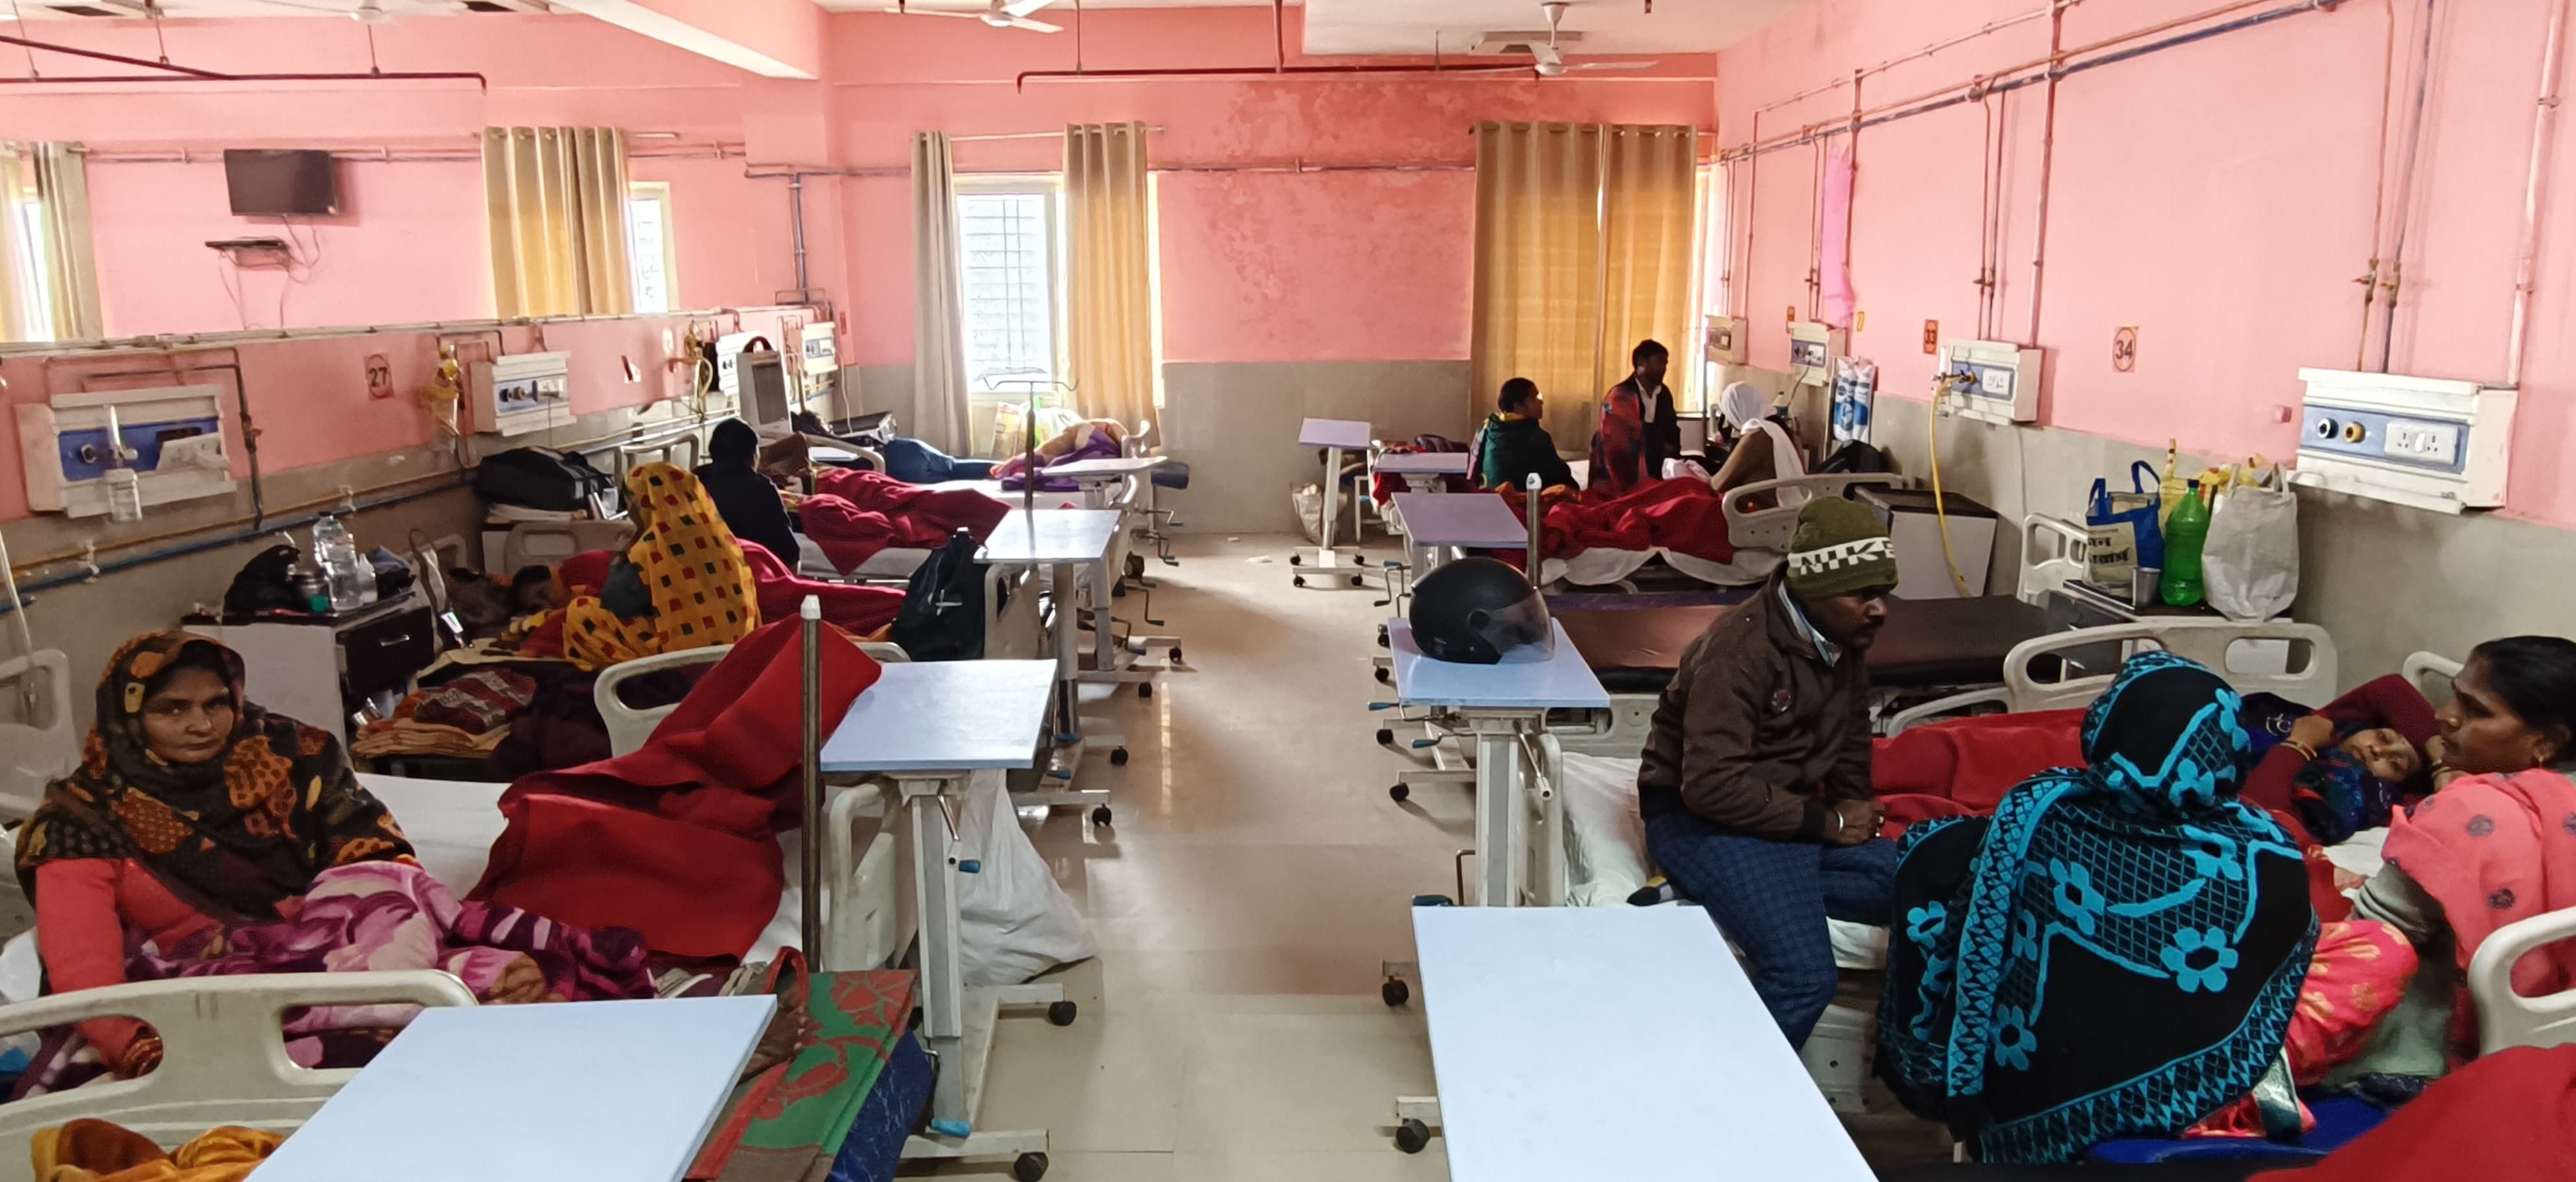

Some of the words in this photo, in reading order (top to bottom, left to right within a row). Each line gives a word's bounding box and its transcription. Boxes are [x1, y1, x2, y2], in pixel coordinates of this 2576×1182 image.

[2116, 339, 2133, 360] 34
[369, 366, 387, 388] 27
[1800, 539, 1895, 575] NIKE
